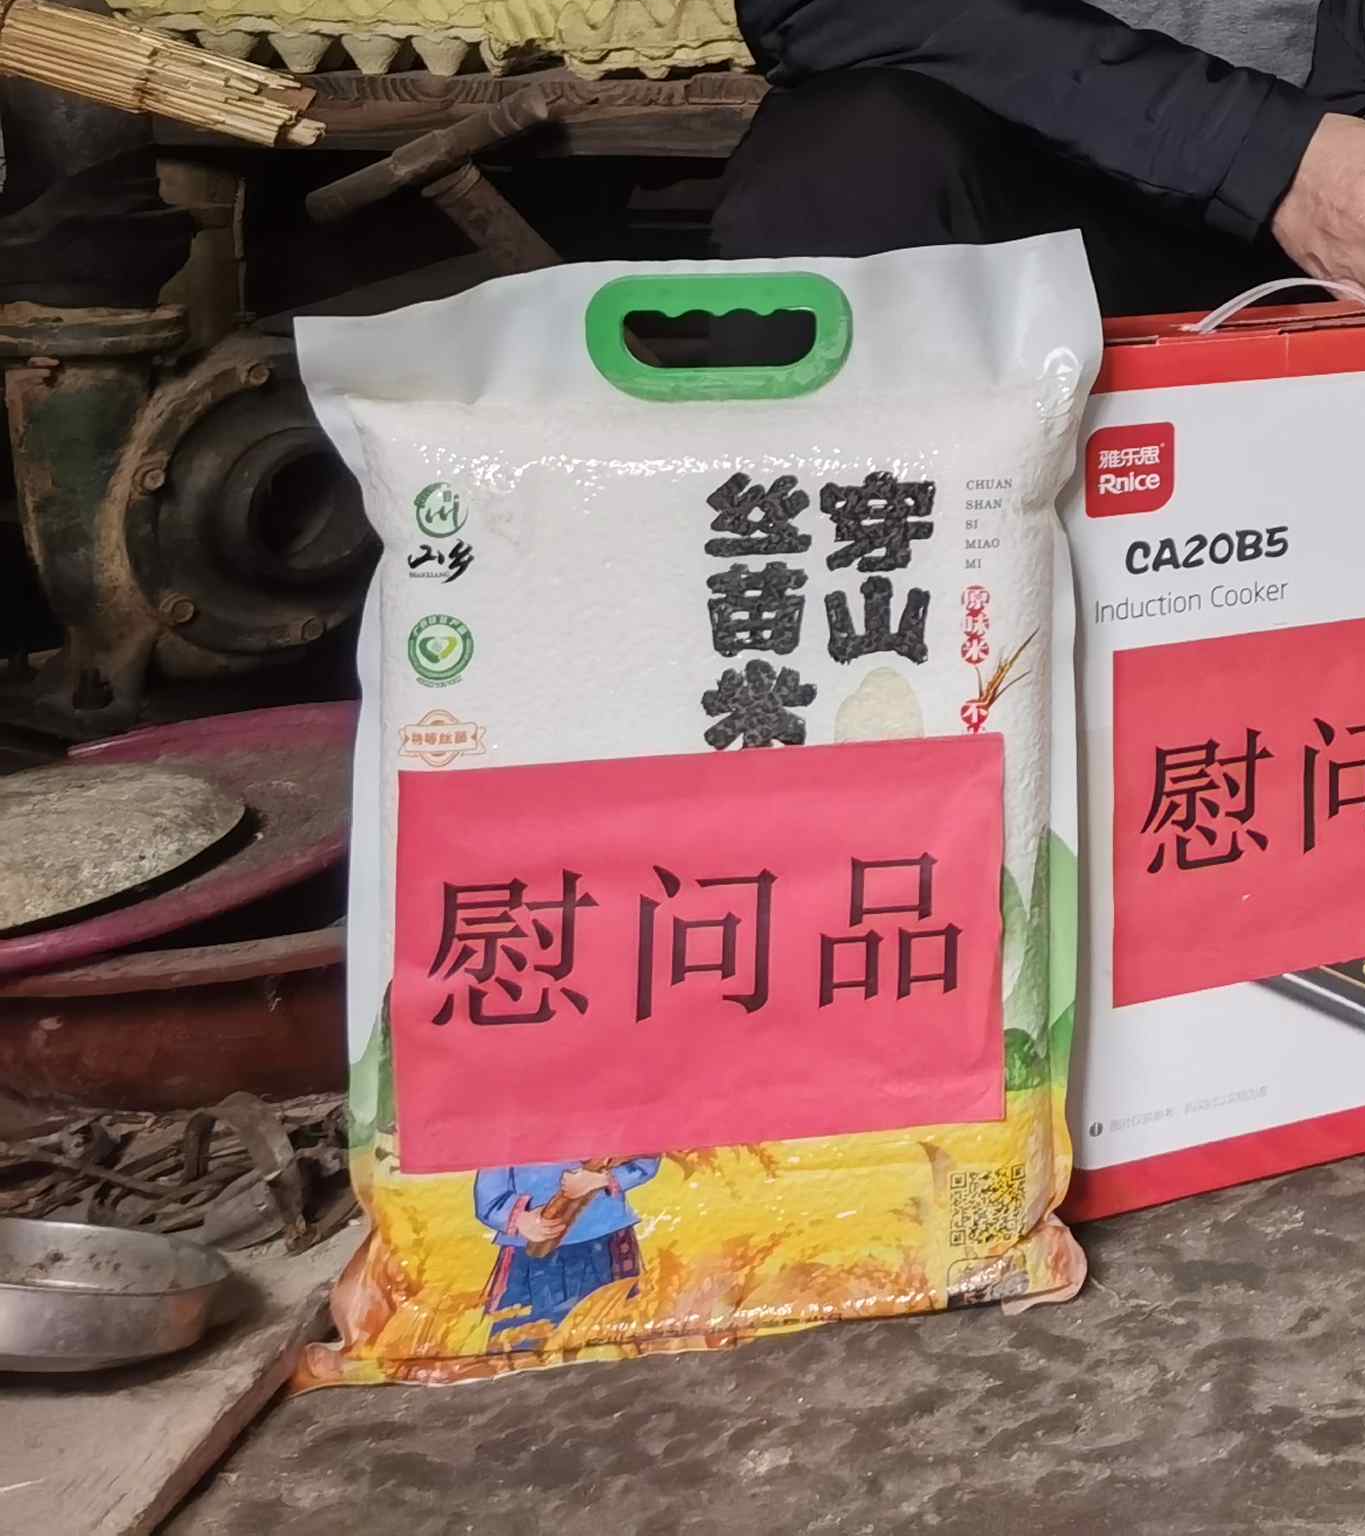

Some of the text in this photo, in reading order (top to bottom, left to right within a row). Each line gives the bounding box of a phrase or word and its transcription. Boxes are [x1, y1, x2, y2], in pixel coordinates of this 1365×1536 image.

[1098, 445, 1160, 470] 雅乐思
[966, 478, 1013, 490] CHUAN
[1098, 472, 1161, 495] Rnice
[965, 498, 1003, 510] SHAN
[965, 518, 979, 530] SI
[965, 538, 1001, 550] MIAO
[1125, 525, 1289, 575] CA20B5
[819, 470, 936, 665] 穿山
[965, 558, 982, 569] MI
[701, 472, 817, 751] 丝苗米
[1095, 580, 1289, 624] Induction Cooker
[426, 851, 963, 1026] 慰问品
